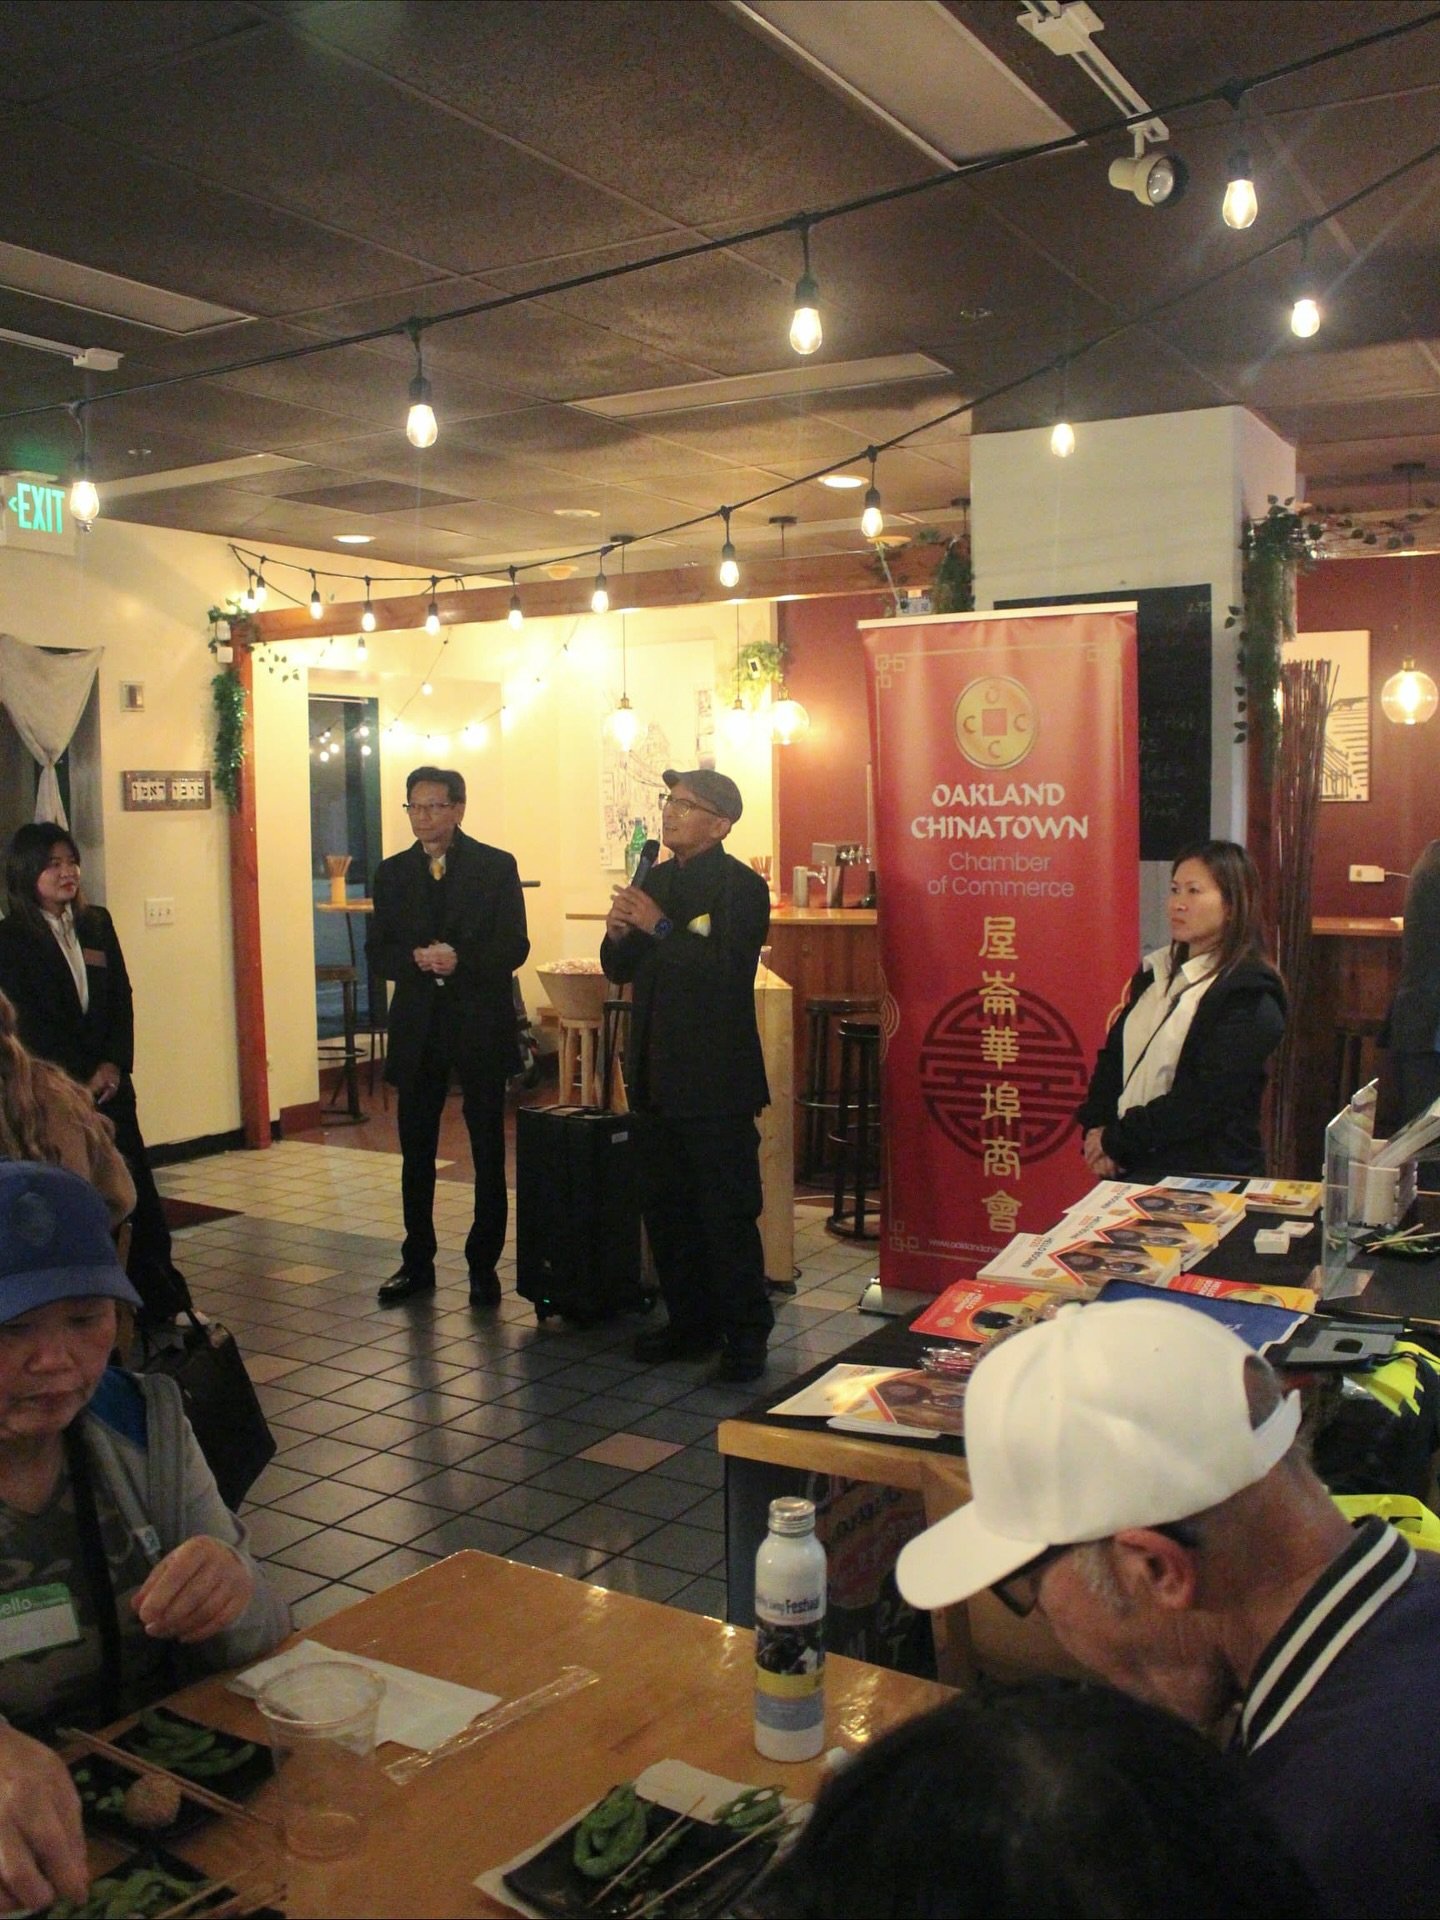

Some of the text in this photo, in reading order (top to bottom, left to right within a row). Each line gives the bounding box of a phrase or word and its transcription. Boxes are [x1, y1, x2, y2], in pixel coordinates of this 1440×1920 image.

[17, 482, 65, 534] EXIT
[932, 783, 1065, 807] OAKLAND
[911, 816, 1088, 839] CHINATOWN
[949, 852, 1051, 872] Chamber
[927, 875, 1075, 897] of Commerce
[978, 916, 1023, 1232] 屋崙華埠商會
[0, 1597, 33, 1615] ello
